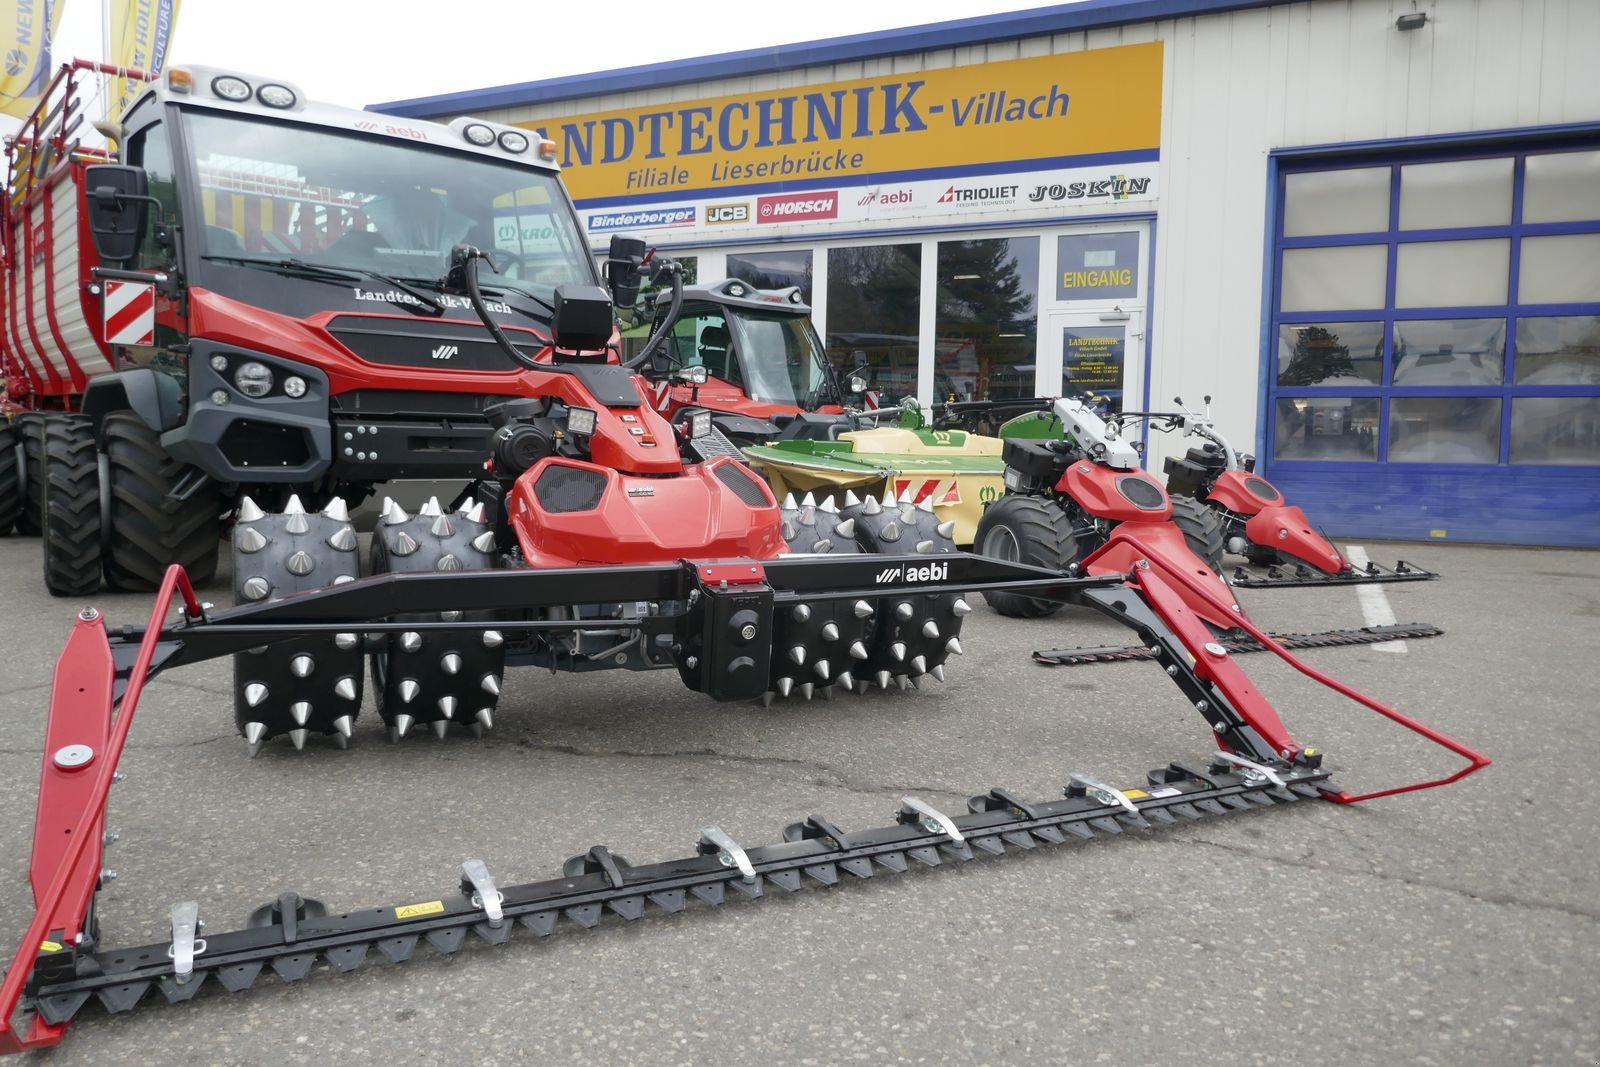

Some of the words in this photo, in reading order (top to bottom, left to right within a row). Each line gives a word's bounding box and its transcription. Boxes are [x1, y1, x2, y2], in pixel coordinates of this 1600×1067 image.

[385, 125, 428, 140] aebi
[626, 165, 689, 189] Filiale
[711, 149, 864, 182] Lieserbrücke
[880, 189, 913, 204] aebi
[954, 185, 1019, 201] TRIOLIET
[1028, 176, 1151, 202] JOSKIN
[773, 199, 834, 216] HORSCH
[981, 199, 1016, 207] TECHNOLOGY
[591, 209, 694, 228] Binderberger
[708, 206, 747, 222] JCB
[1063, 268, 1132, 288] EINGANG
[906, 562, 948, 582] aebi
